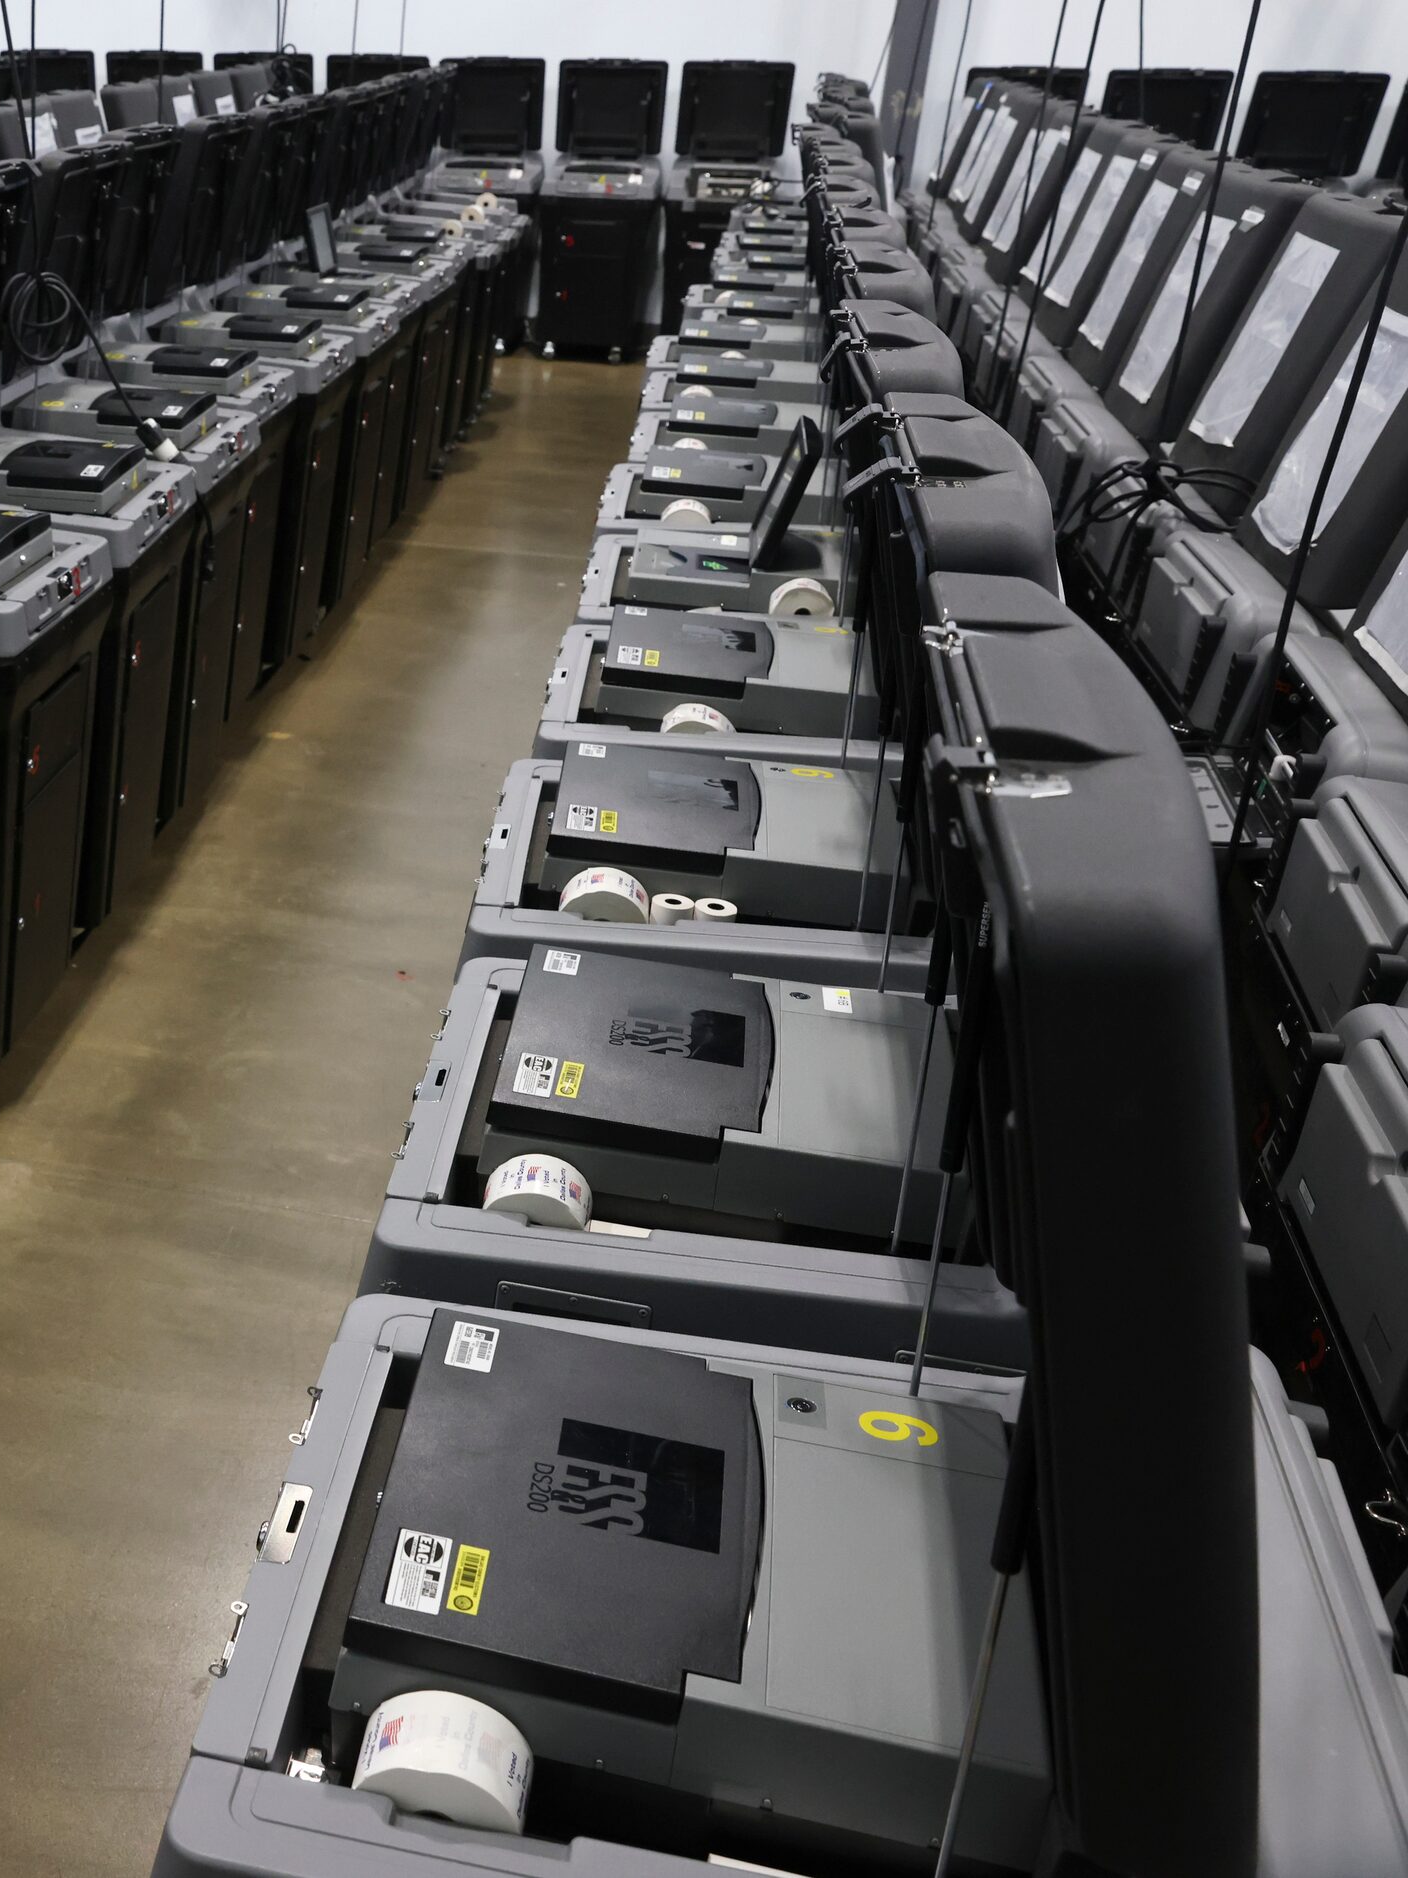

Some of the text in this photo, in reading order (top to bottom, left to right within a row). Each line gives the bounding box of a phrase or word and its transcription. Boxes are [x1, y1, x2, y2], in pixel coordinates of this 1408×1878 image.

[790, 767, 834, 779] 6
[609, 1019, 626, 1046] DS200
[858, 1410, 940, 1447] 6
[527, 1461, 555, 1514] DS200
[415, 1535, 435, 1565] EAC
[508, 1751, 518, 1782] Voted
